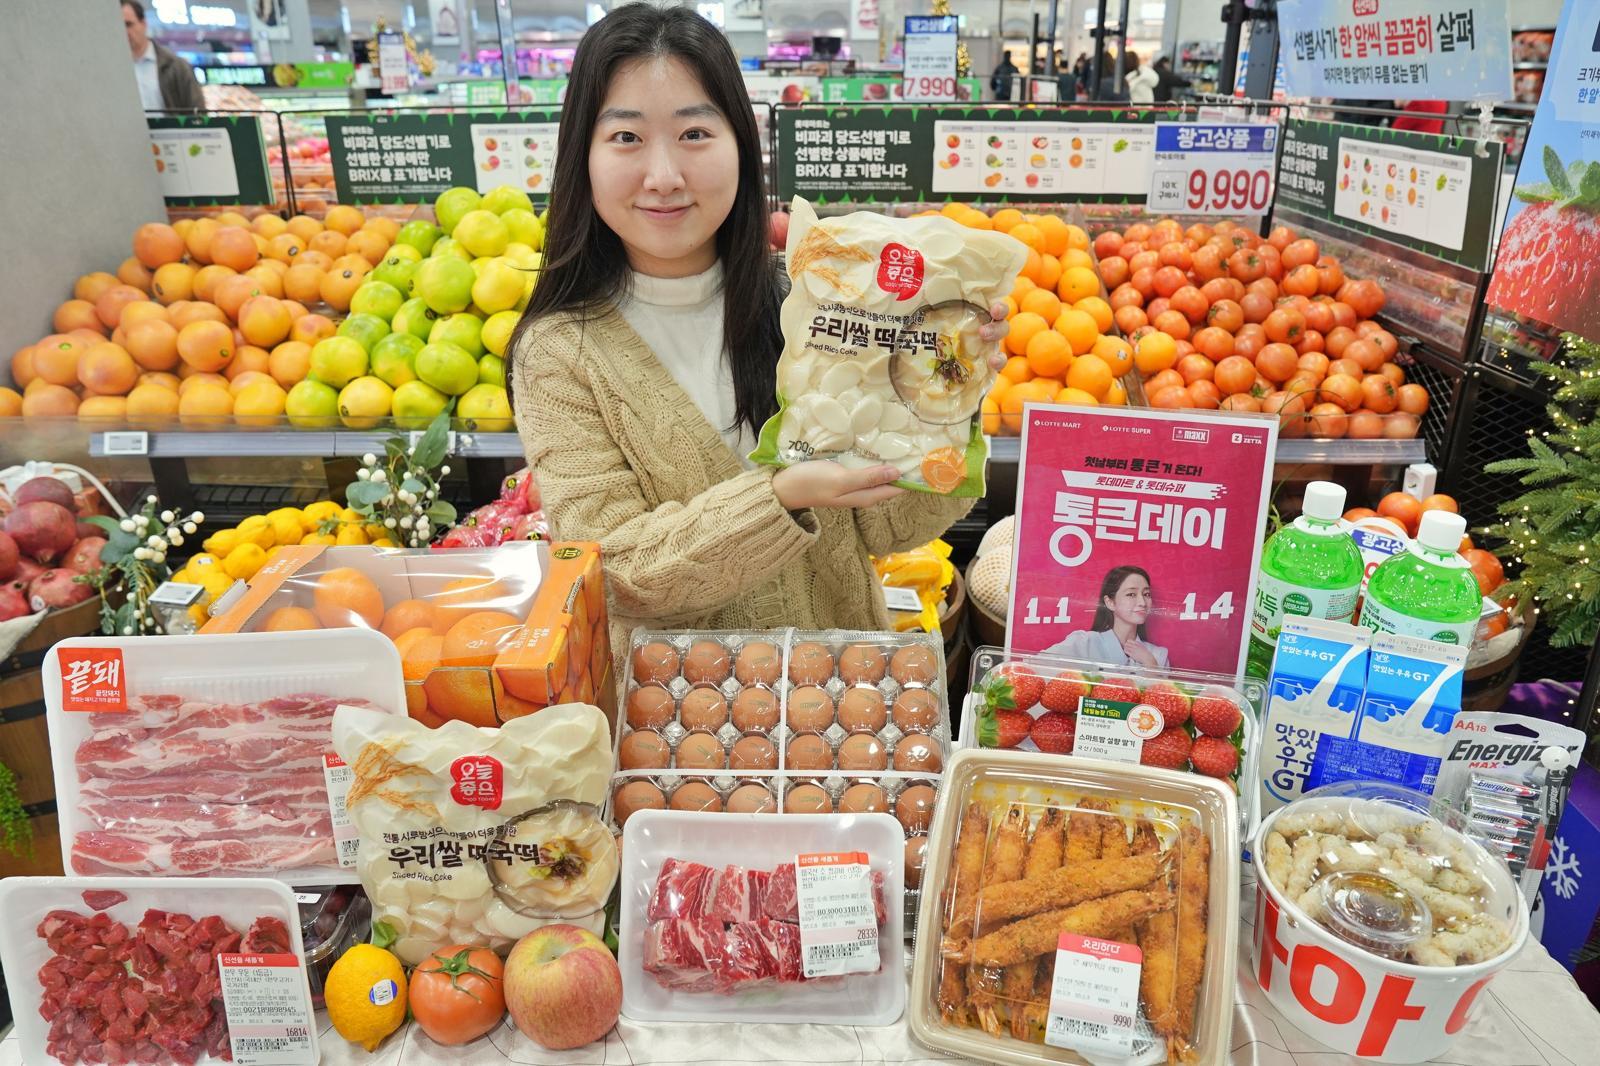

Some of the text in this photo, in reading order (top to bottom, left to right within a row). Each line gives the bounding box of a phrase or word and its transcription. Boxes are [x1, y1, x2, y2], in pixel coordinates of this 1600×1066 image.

[1294, 27, 1337, 60] 선별사가
[1339, 25, 1352, 58] 한
[1354, 22, 1382, 58] 알씩
[1385, 14, 1433, 55] 꼼꼼히
[1324, 68, 1343, 84] 마지막
[1374, 65, 1390, 84] 무름
[1391, 64, 1409, 84] 없는
[1409, 63, 1428, 83] 딸기
[344, 135, 452, 150] 비파괴 당도선별기로
[795, 130, 912, 145] 비파괴 당도선별기로
[1177, 127, 1251, 149] 광고상품
[346, 152, 381, 167] 선별한
[795, 147, 886, 161] 선별한 상품에만
[349, 168, 453, 182] BRIX를 표기합니다
[795, 163, 908, 178] BRIX를 표기합니다
[1187, 169, 1270, 212] 9,990
[809, 315, 938, 357] 우리쌀 떡국떡
[788, 440, 815, 456] 700g
[1084, 456, 1128, 470] 첫날부터
[1175, 464, 1203, 476] 온다!
[1096, 477, 1186, 494] 롯데마트 & 롯데슈퍼
[1049, 491, 1227, 567] 통큰데이
[1024, 596, 1071, 625] 1.1
[1179, 591, 1234, 621] 1.4
[1281, 645, 1302, 656] 맛있는
[1319, 652, 1337, 662] GT
[63, 659, 120, 695] 끝돼
[1373, 664, 1396, 674] 맛있는
[1413, 672, 1431, 683] GT
[1122, 740, 1136, 748] 딸기
[1275, 723, 1318, 750] 맛있
[1447, 740, 1578, 766] Energizr
[1478, 780, 1515, 793] Energizer
[1473, 812, 1510, 825] Energizer
[383, 832, 399, 844] 전통
[401, 826, 449, 842] 시루방식으
[388, 840, 540, 869] 우리쌀 떡국떡
[1082, 939, 1120, 954] 요리하다
[1113, 1014, 1132, 1028] 9990
[286, 1027, 307, 1037] 16814
